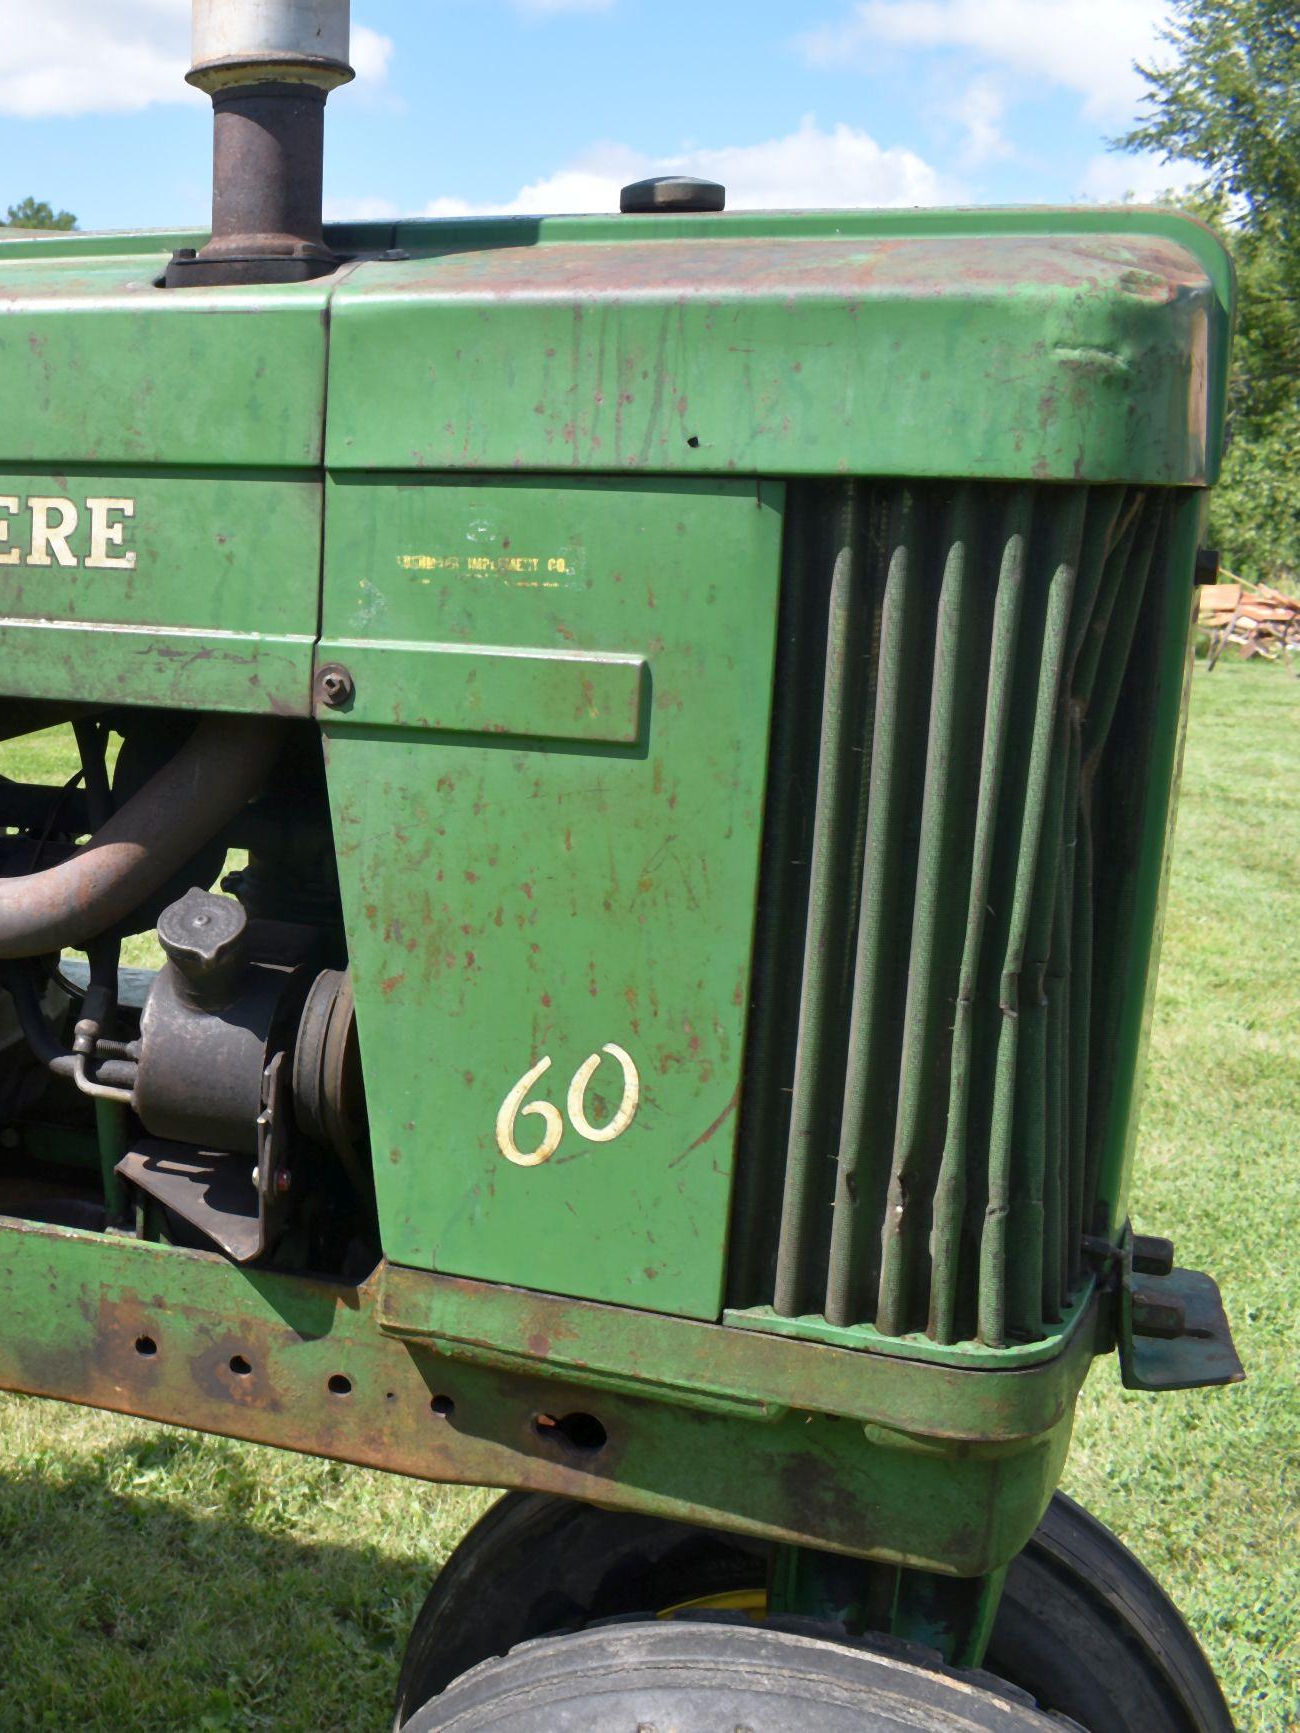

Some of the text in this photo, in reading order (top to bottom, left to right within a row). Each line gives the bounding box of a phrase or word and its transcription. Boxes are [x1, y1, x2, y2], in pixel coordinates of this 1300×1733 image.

[467, 556, 539, 573] IMPLMENT
[547, 557, 570, 574] CO.
[496, 1042, 640, 1167] 60
